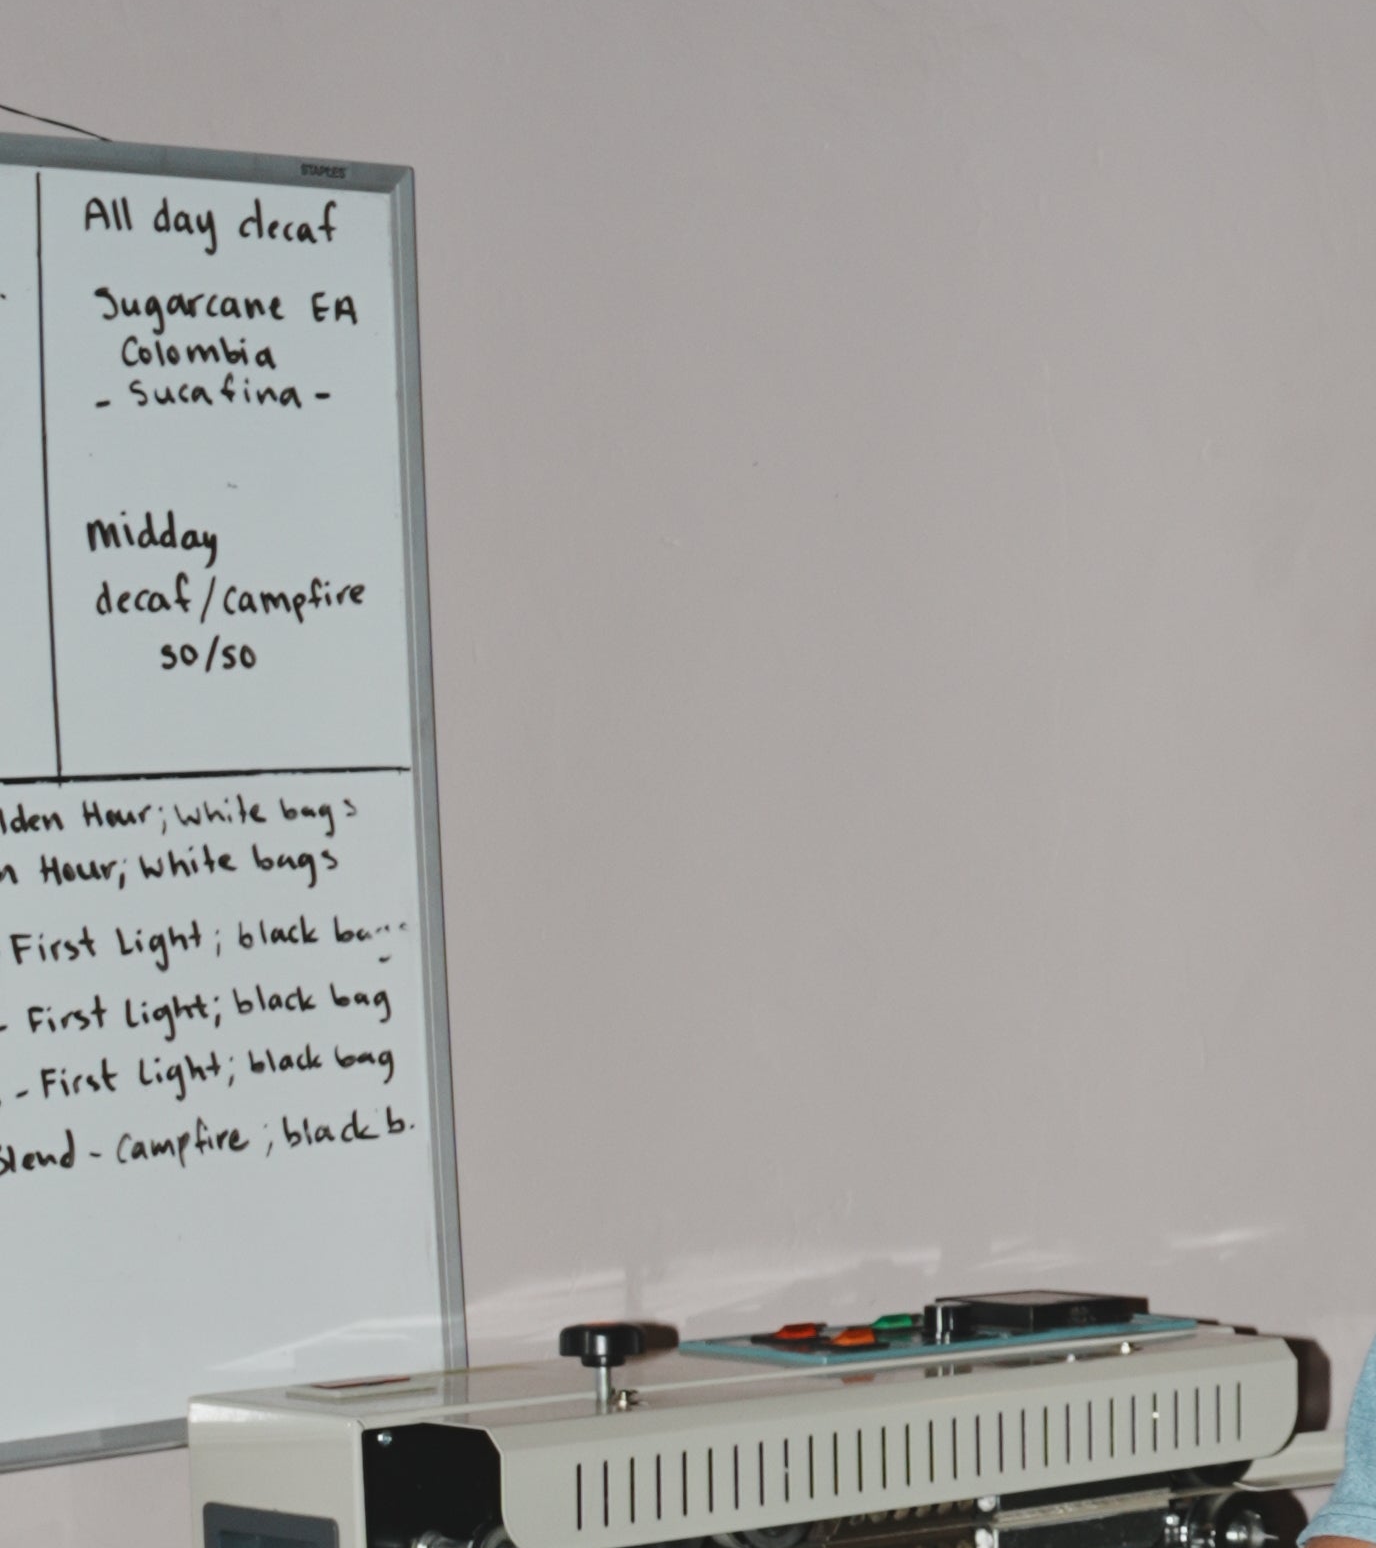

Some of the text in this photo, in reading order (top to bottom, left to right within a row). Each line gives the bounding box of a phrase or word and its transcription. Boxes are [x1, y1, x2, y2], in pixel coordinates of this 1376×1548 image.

[84, 196, 337, 256] All day decaf
[94, 286, 358, 332] Sugarcane EA
[121, 336, 277, 371] Colombia
[128, 373, 302, 409] Sucafina
[174, 794, 267, 826] white
[279, 798, 357, 836] bags
[138, 846, 237, 879] white
[251, 844, 338, 889] bags
[9, 926, 96, 965] First
[238, 915, 319, 949] black
[27, 994, 107, 1033] First
[232, 984, 316, 1015] black
[329, 983, 392, 1024] bag
[40, 1058, 117, 1098] First
[248, 1044, 323, 1074] black
[334, 1047, 395, 1085] bag
[282, 1109, 380, 1148] black
